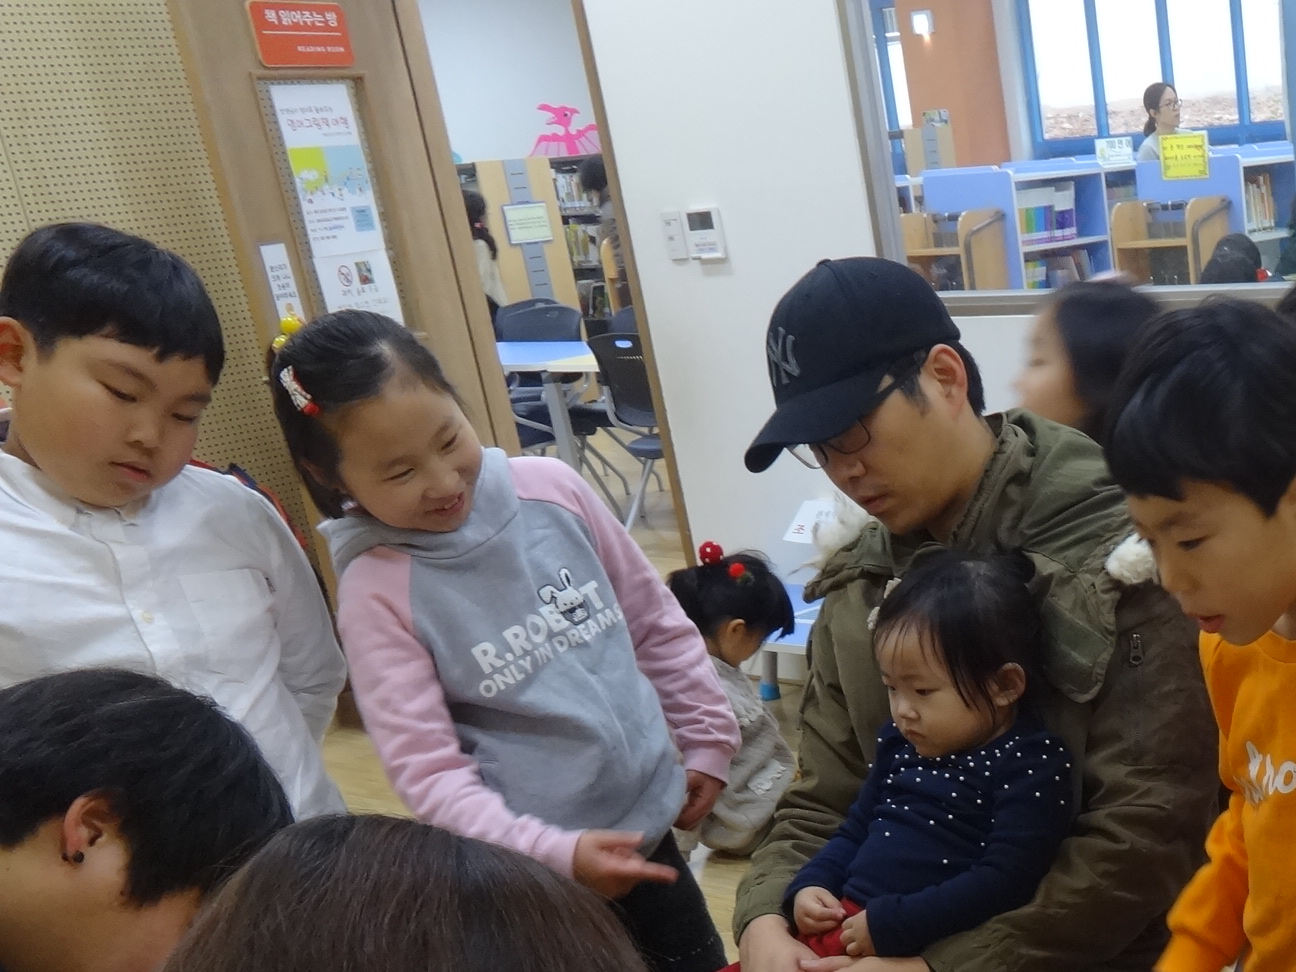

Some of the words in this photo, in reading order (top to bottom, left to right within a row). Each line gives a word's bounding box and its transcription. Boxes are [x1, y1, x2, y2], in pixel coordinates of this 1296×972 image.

[264, 8, 279, 25] 책
[279, 9, 325, 27] 읽어주는
[325, 11, 338, 27] 방
[479, 655, 533, 698] ONLY
[533, 643, 554, 666] IN
[552, 603, 623, 653] DREAMS
